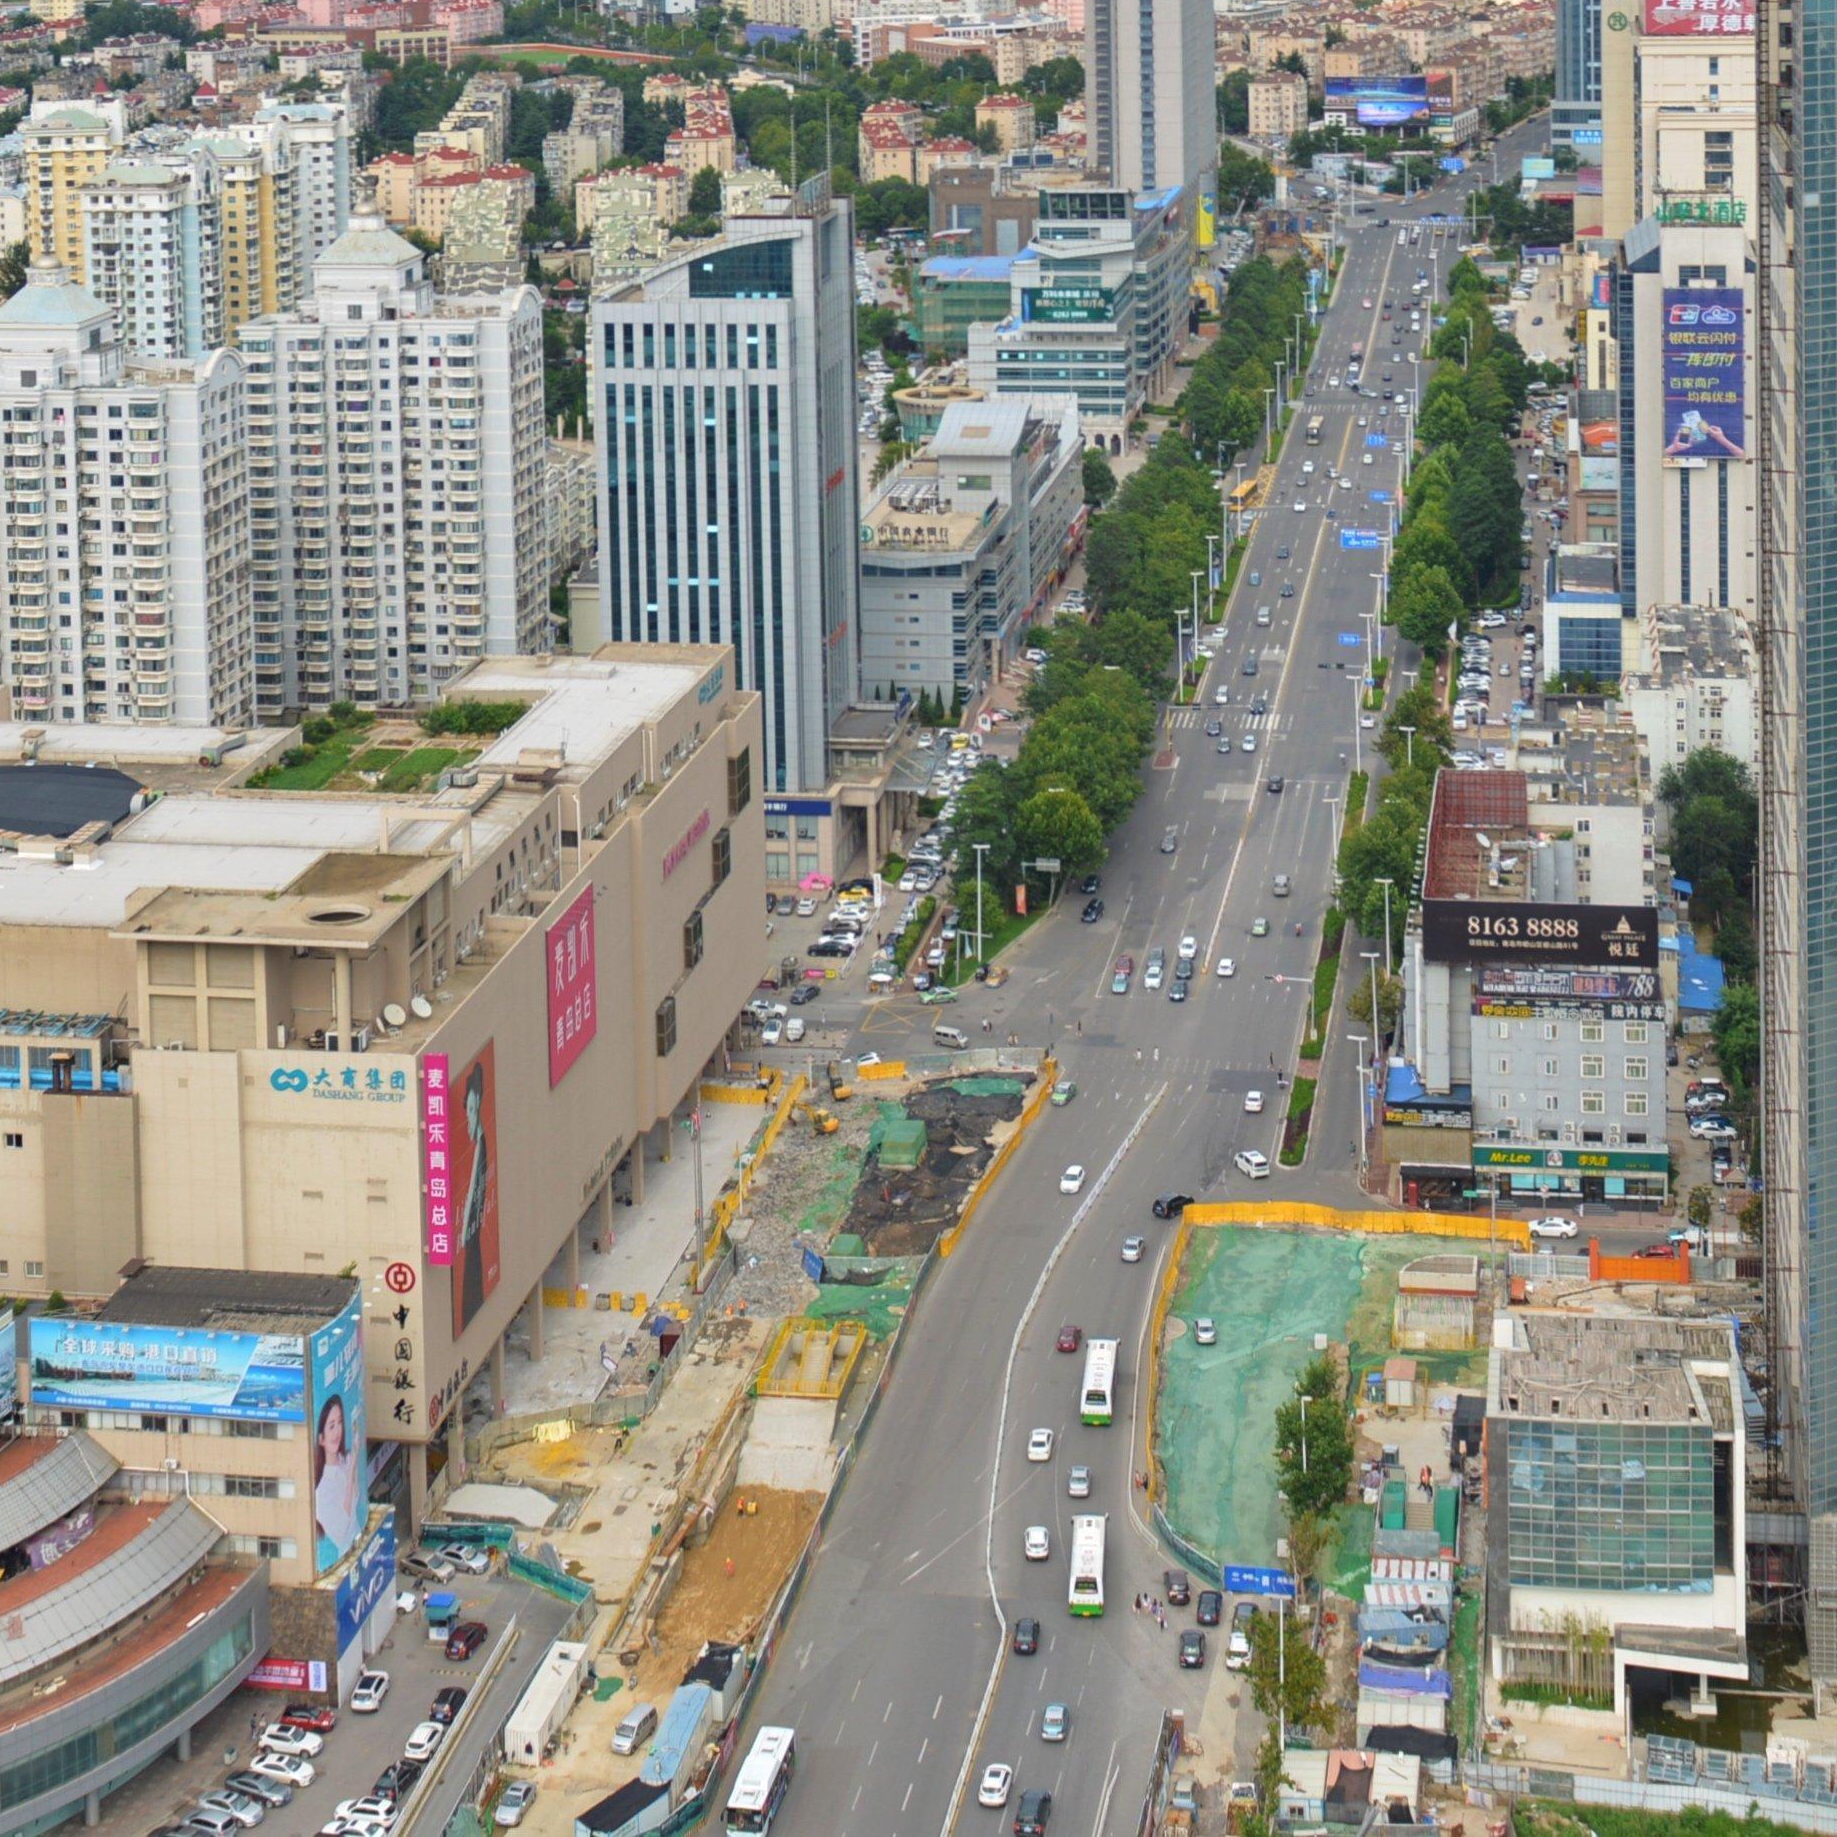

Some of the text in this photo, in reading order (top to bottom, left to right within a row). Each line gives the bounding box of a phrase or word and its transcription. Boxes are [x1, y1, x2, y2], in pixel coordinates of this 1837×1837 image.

[1669, 332, 1737, 345] 银联云闪付
[1467, 916, 1579, 938] 8163 8888
[313, 1067, 406, 1091] 大商集团
[313, 1089, 406, 1103] DASHANG GROUP
[427, 1069, 448, 1254] 麦凯乐青岛总店
[1490, 1151, 1532, 1164] Mr.Lee
[64, 1338, 217, 1363] 全球采购 港口直销
